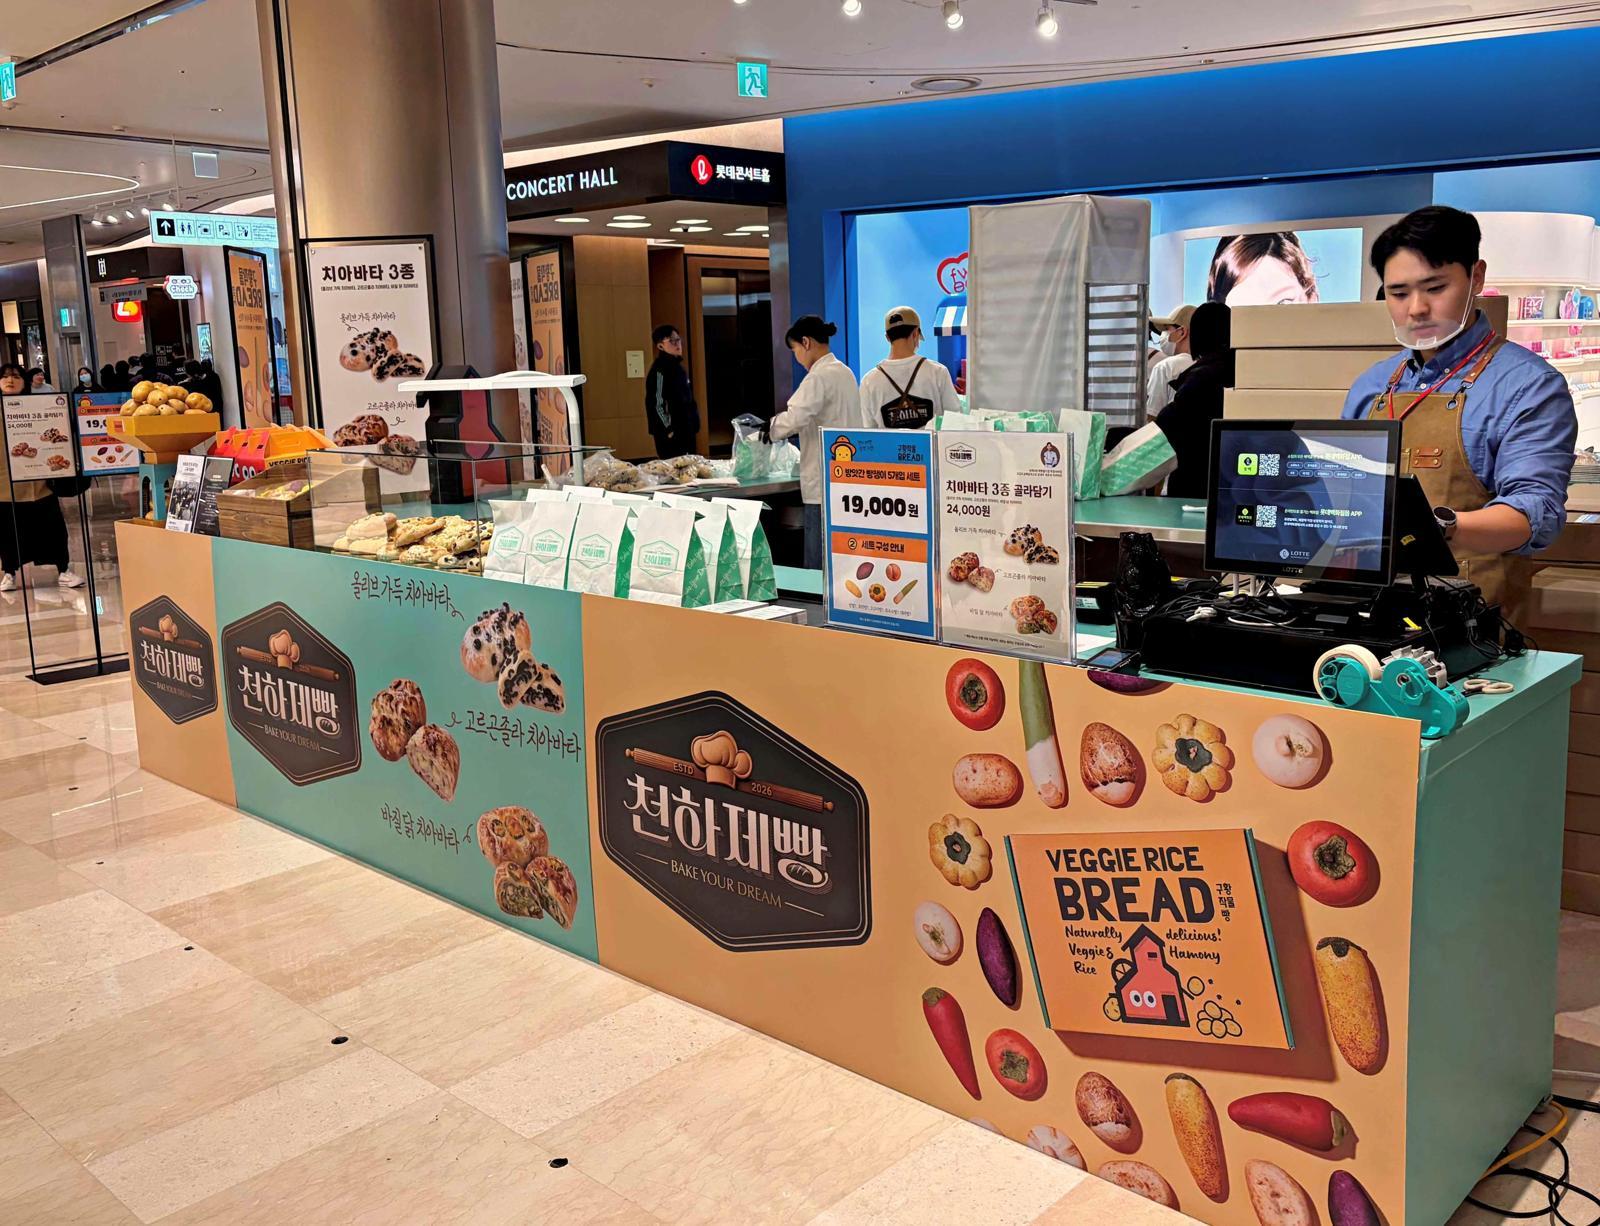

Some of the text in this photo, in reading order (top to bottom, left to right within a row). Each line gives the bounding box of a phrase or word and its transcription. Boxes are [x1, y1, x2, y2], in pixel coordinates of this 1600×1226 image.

[506, 166, 618, 200] CONCERT HALL
[716, 164, 770, 183] 롯데콘서트홀
[322, 264, 414, 282] 치아바타 3종
[372, 312, 396, 321] 치아바타
[397, 400, 417, 410] 치아바
[845, 468, 865, 478] 방앗간
[906, 472, 920, 481] 세트
[946, 480, 1052, 498] 치아바타 3종 골라담기
[946, 504, 990, 517] 24,000원
[862, 540, 875, 550] 세트
[876, 542, 889, 552] 구성
[890, 543, 904, 553] 안내
[352, 570, 451, 612] 올리브 가득 치아바타
[141, 640, 204, 688] 천하제빵
[238, 665, 340, 735] 천하제빵
[264, 725, 320, 752] BAKE YOUR DREAM
[465, 710, 581, 762] 고르곤졸라 치아바타
[673, 763, 772, 796] ESTD 2026
[381, 803, 460, 854] 바질 닭 치아바타
[623, 774, 829, 888] 천하제빵
[1046, 847, 1204, 872] VEGGIE RICE
[672, 860, 782, 908] BAKE YOUR DREAM
[1054, 877, 1215, 923] BREAD
[1221, 909, 1230, 922] 빵
[1065, 925, 1222, 943] Naturally delicious!
[1169, 946, 1220, 964] Hamony
[1074, 961, 1096, 974] Rice
